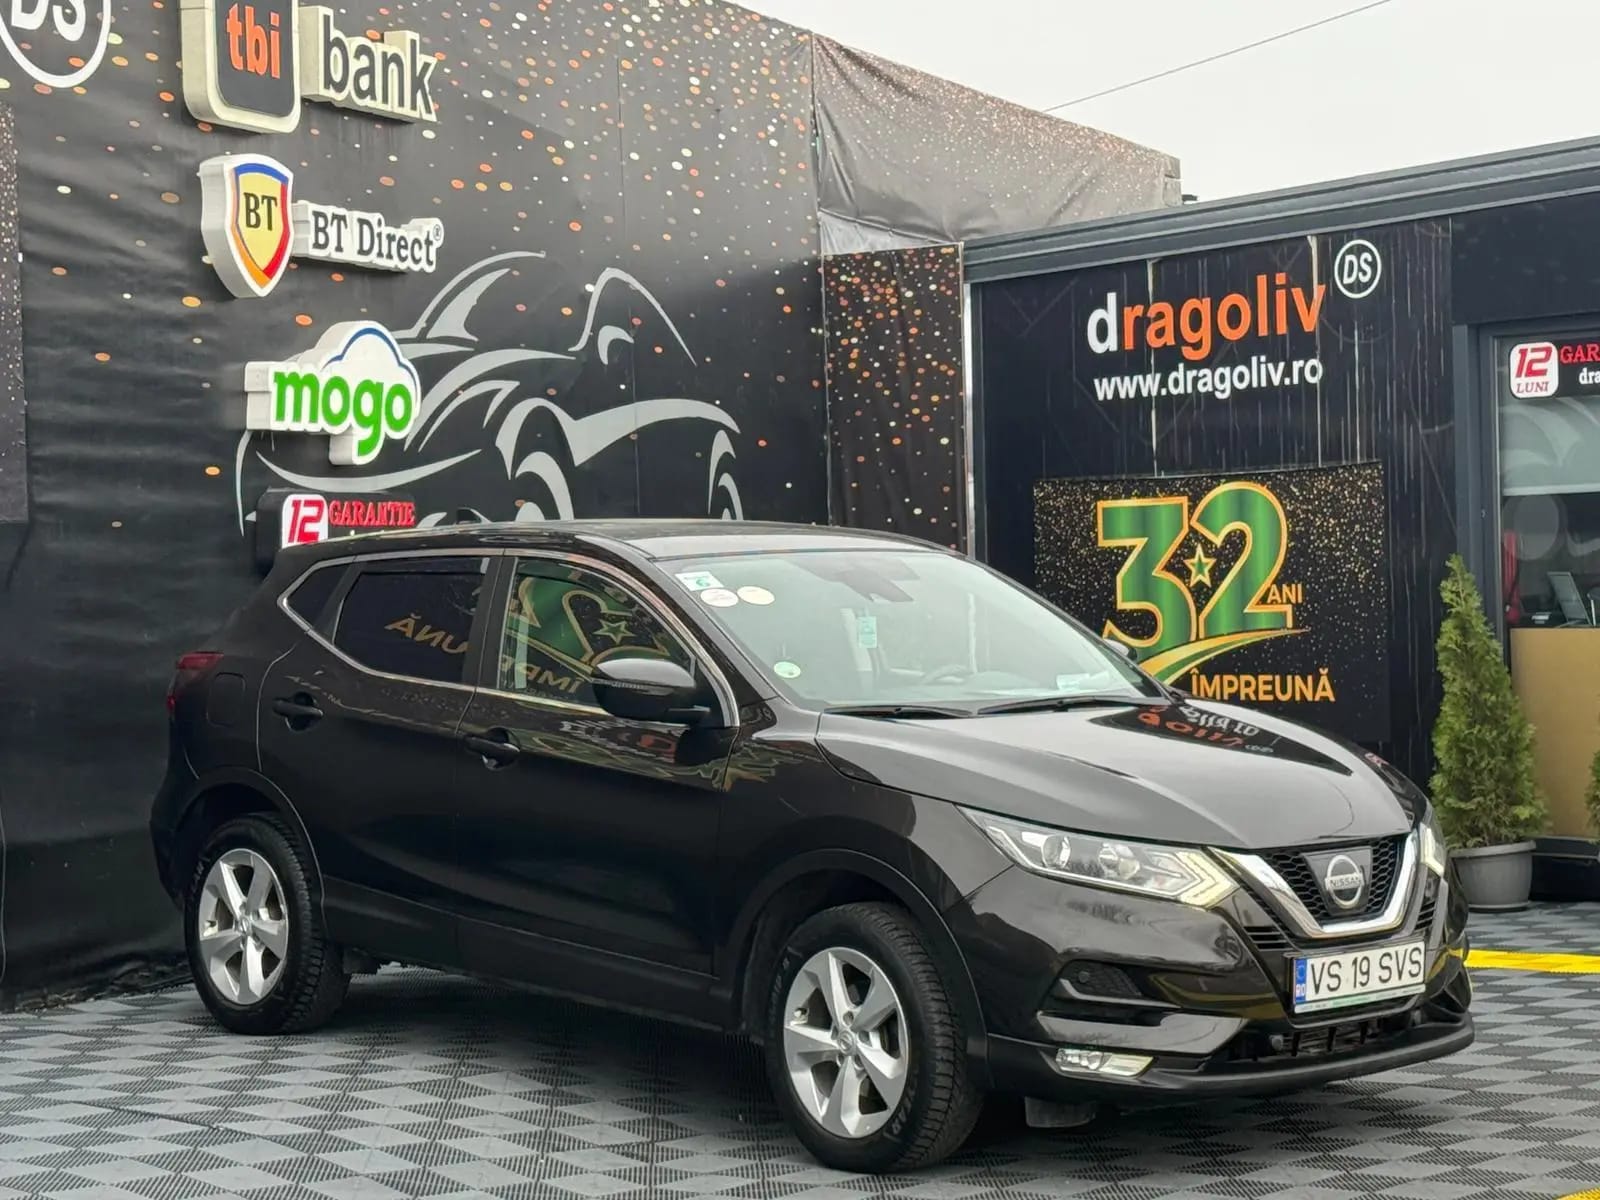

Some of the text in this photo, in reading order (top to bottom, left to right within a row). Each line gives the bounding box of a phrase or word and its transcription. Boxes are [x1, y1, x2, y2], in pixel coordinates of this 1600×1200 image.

[226, 3, 281, 78] tbi
[324, 15, 437, 121] bank
[243, 192, 277, 231] BT
[312, 210, 347, 252] BT
[1343, 254, 1373, 284] DS
[1086, 272, 1326, 361] dragoliv
[1094, 356, 1323, 400] www.dragoliv.ro
[1515, 346, 1553, 378] 12
[1516, 381, 1549, 394] LUNI
[274, 371, 412, 456] mogo
[288, 499, 415, 543] 12 GARANTIE
[1097, 481, 1293, 664] 32
[1267, 584, 1303, 604] ANI
[1191, 667, 1336, 702] ÎMPREUNĂ
[1330, 875, 1360, 887] NISSAN
[1311, 947, 1422, 995] VS 19 SVS
